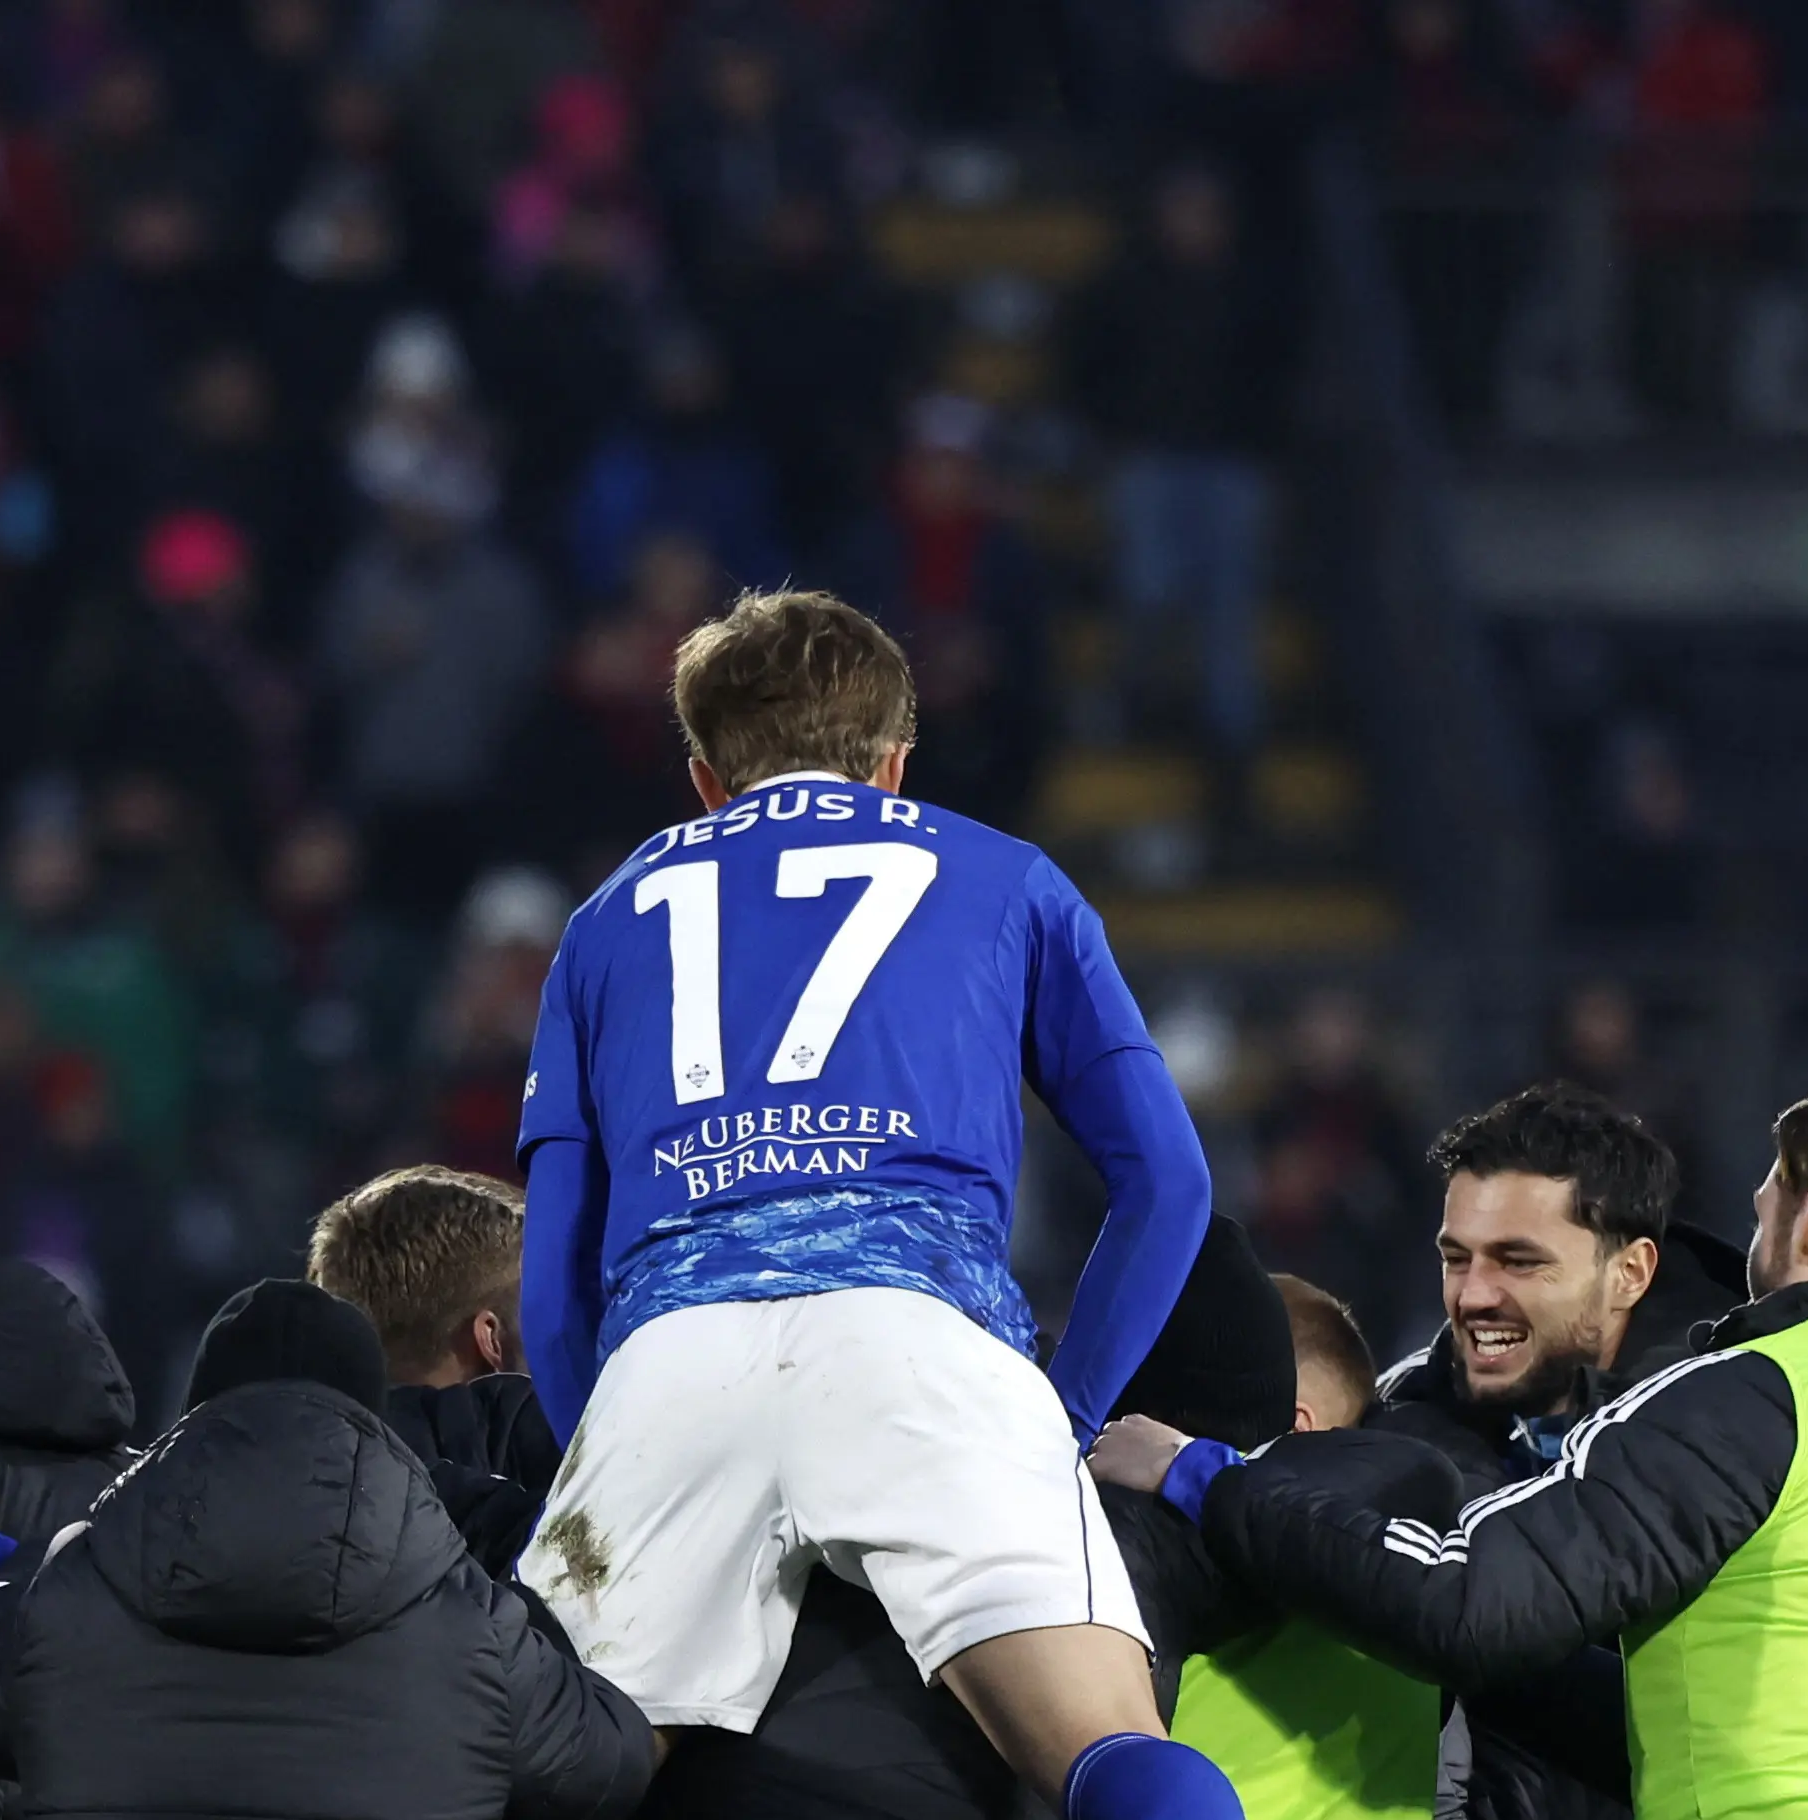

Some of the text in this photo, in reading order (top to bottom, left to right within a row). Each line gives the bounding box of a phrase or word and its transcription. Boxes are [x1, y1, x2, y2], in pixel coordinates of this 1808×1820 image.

[881, 794, 938, 835] R.
[633, 841, 938, 1106] 17
[653, 1103, 918, 1177] NEUBERGER
[683, 1146, 870, 1202] BERMAN
